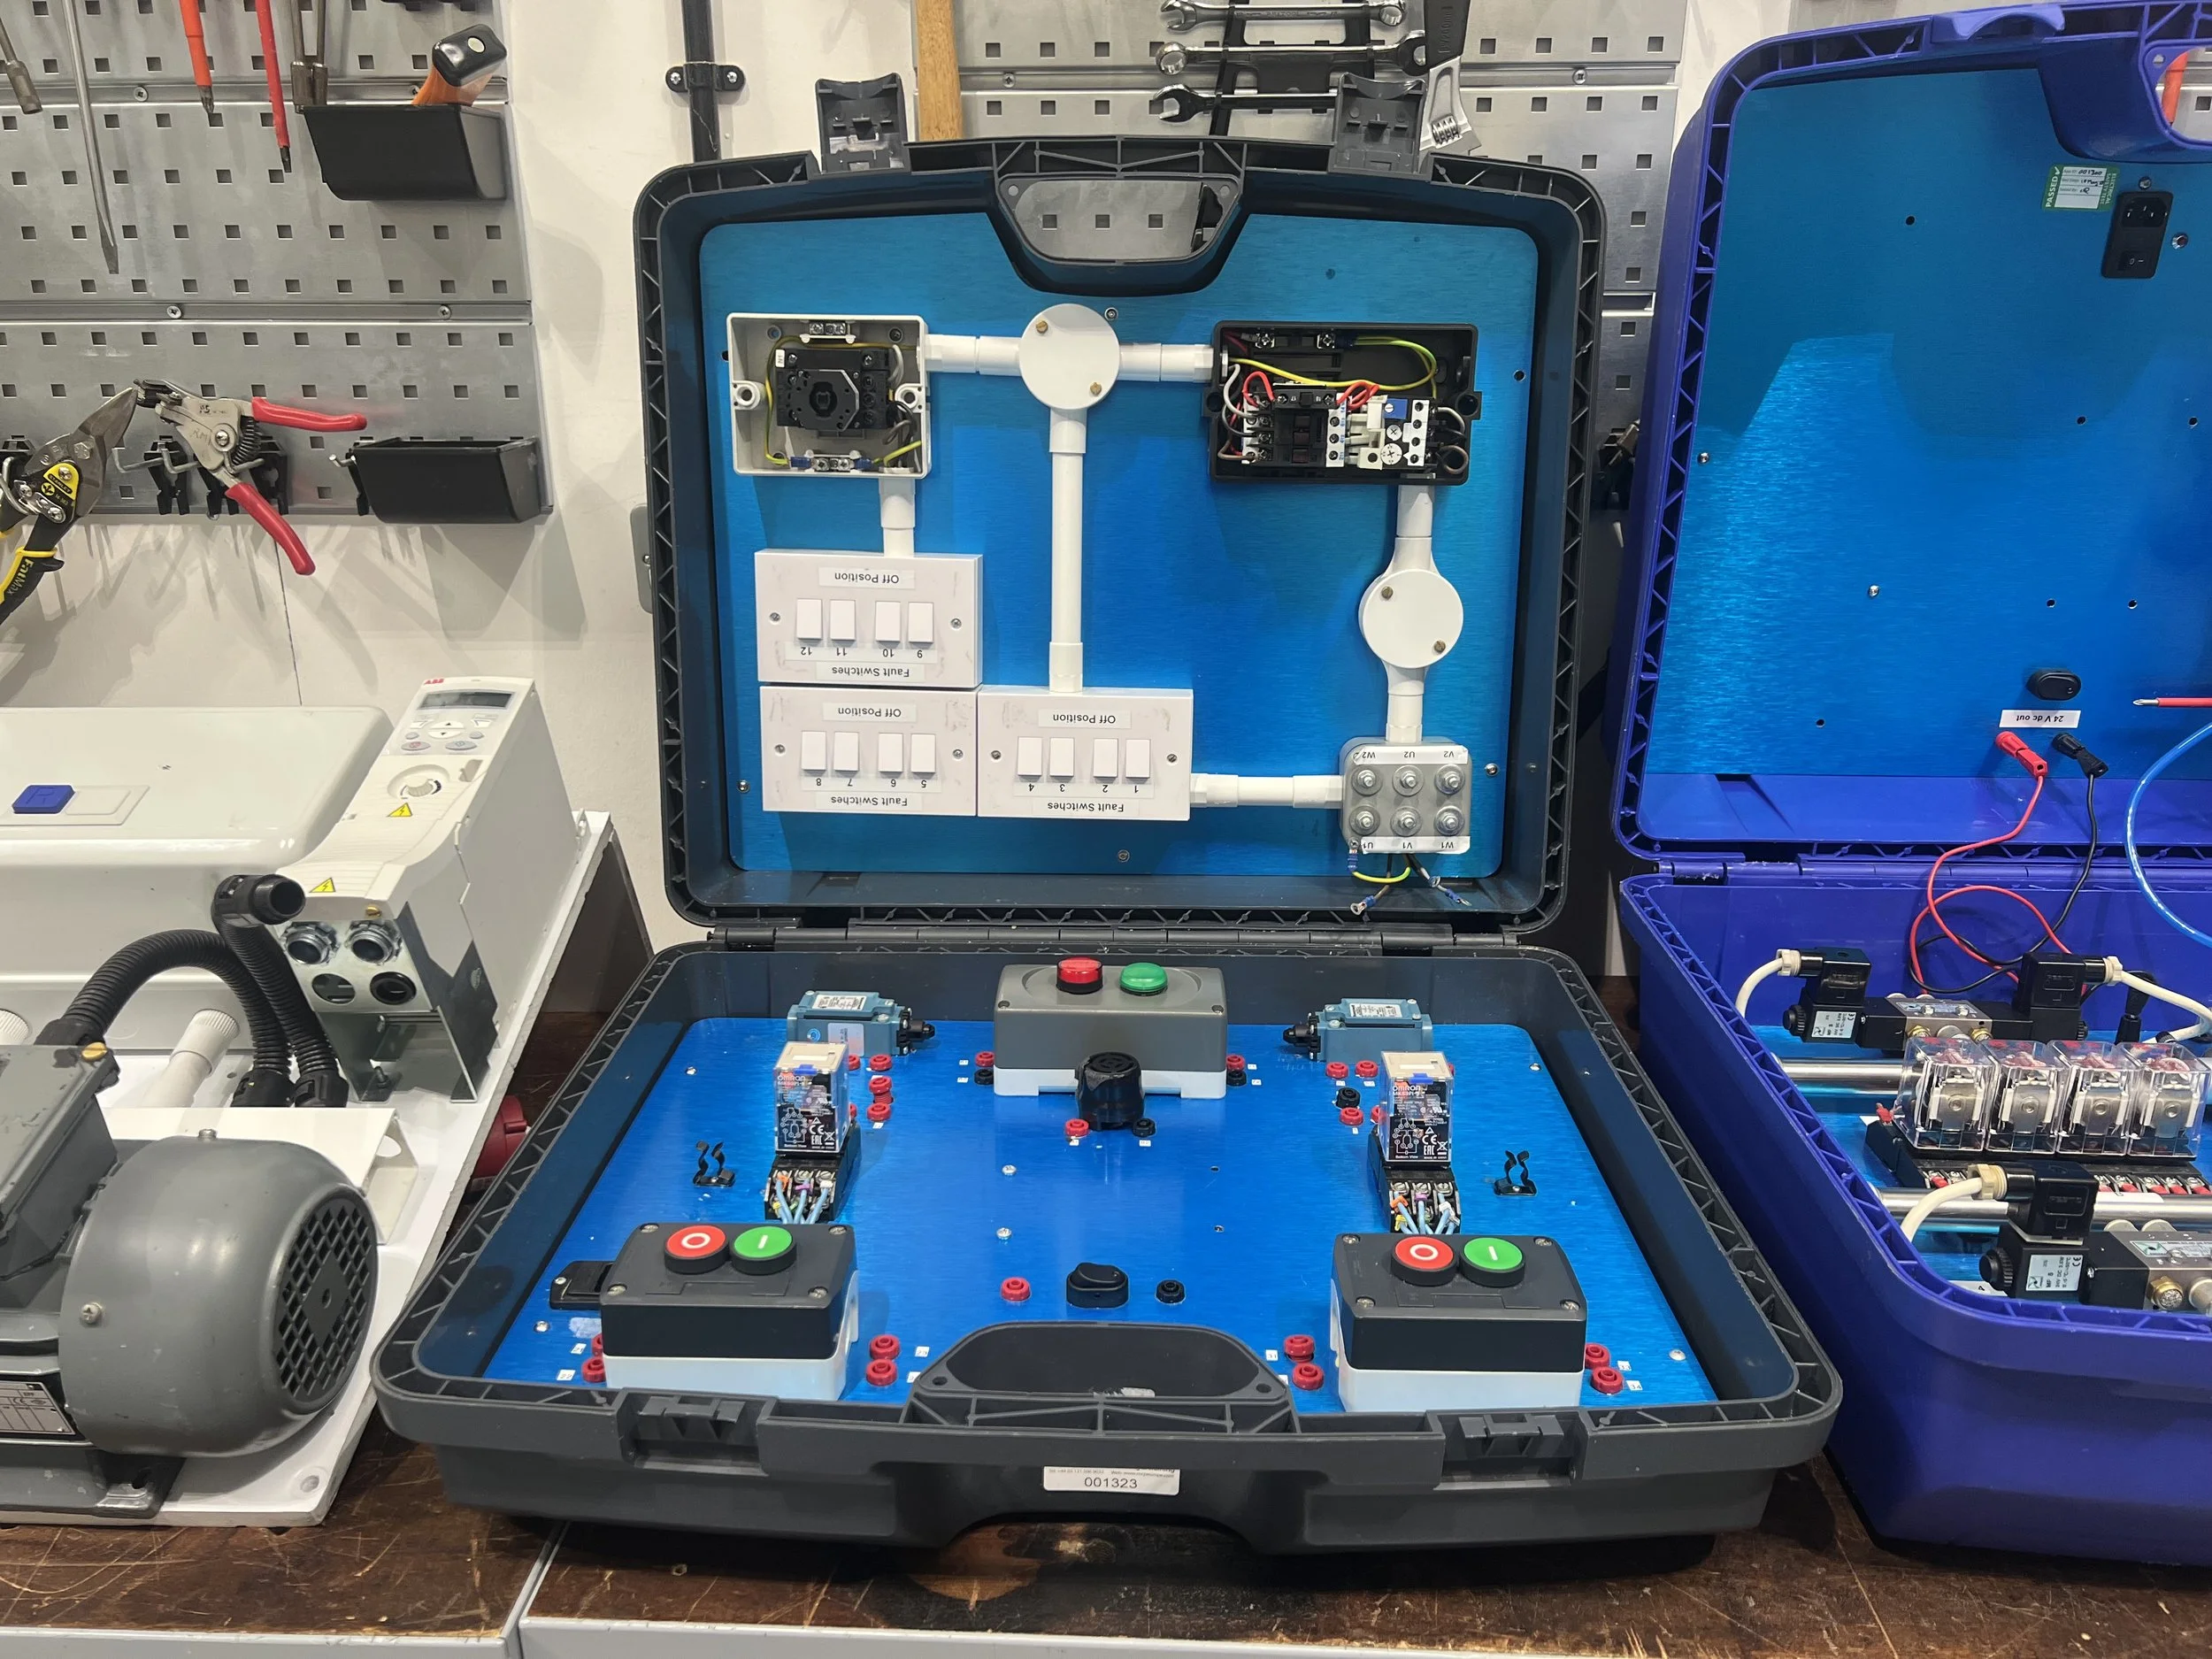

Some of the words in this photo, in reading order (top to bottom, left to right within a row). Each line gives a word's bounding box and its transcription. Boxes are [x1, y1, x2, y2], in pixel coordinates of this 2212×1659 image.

[2045, 176, 2058, 208] PASSED
[2105, 173, 2117, 204] ELECTRICAL
[6, 558, 35, 595] FatMax
[834, 572, 879, 584] Position
[881, 574, 900, 584] Off
[800, 647, 813, 657] 12
[835, 647, 848, 657] 11
[882, 648, 895, 658] 10
[832, 666, 879, 677] Switches
[883, 668, 910, 678] Fault
[838, 707, 881, 718] Position
[885, 708, 902, 718] Off
[1053, 714, 1096, 724] Position
[1099, 715, 1116, 724] Off
[816, 778, 822, 787] 8
[890, 779, 896, 787] 6
[921, 780, 927, 788] 5
[1028, 783, 1034, 792] 4
[1102, 785, 1109, 794] 2
[1134, 785, 1139, 794] 1
[831, 796, 879, 806] Switches
[881, 797, 908, 806] Fault
[1048, 802, 1094, 812] Switches
[1098, 803, 1125, 812] Fault
[1084, 1477, 1138, 1489] 001323
